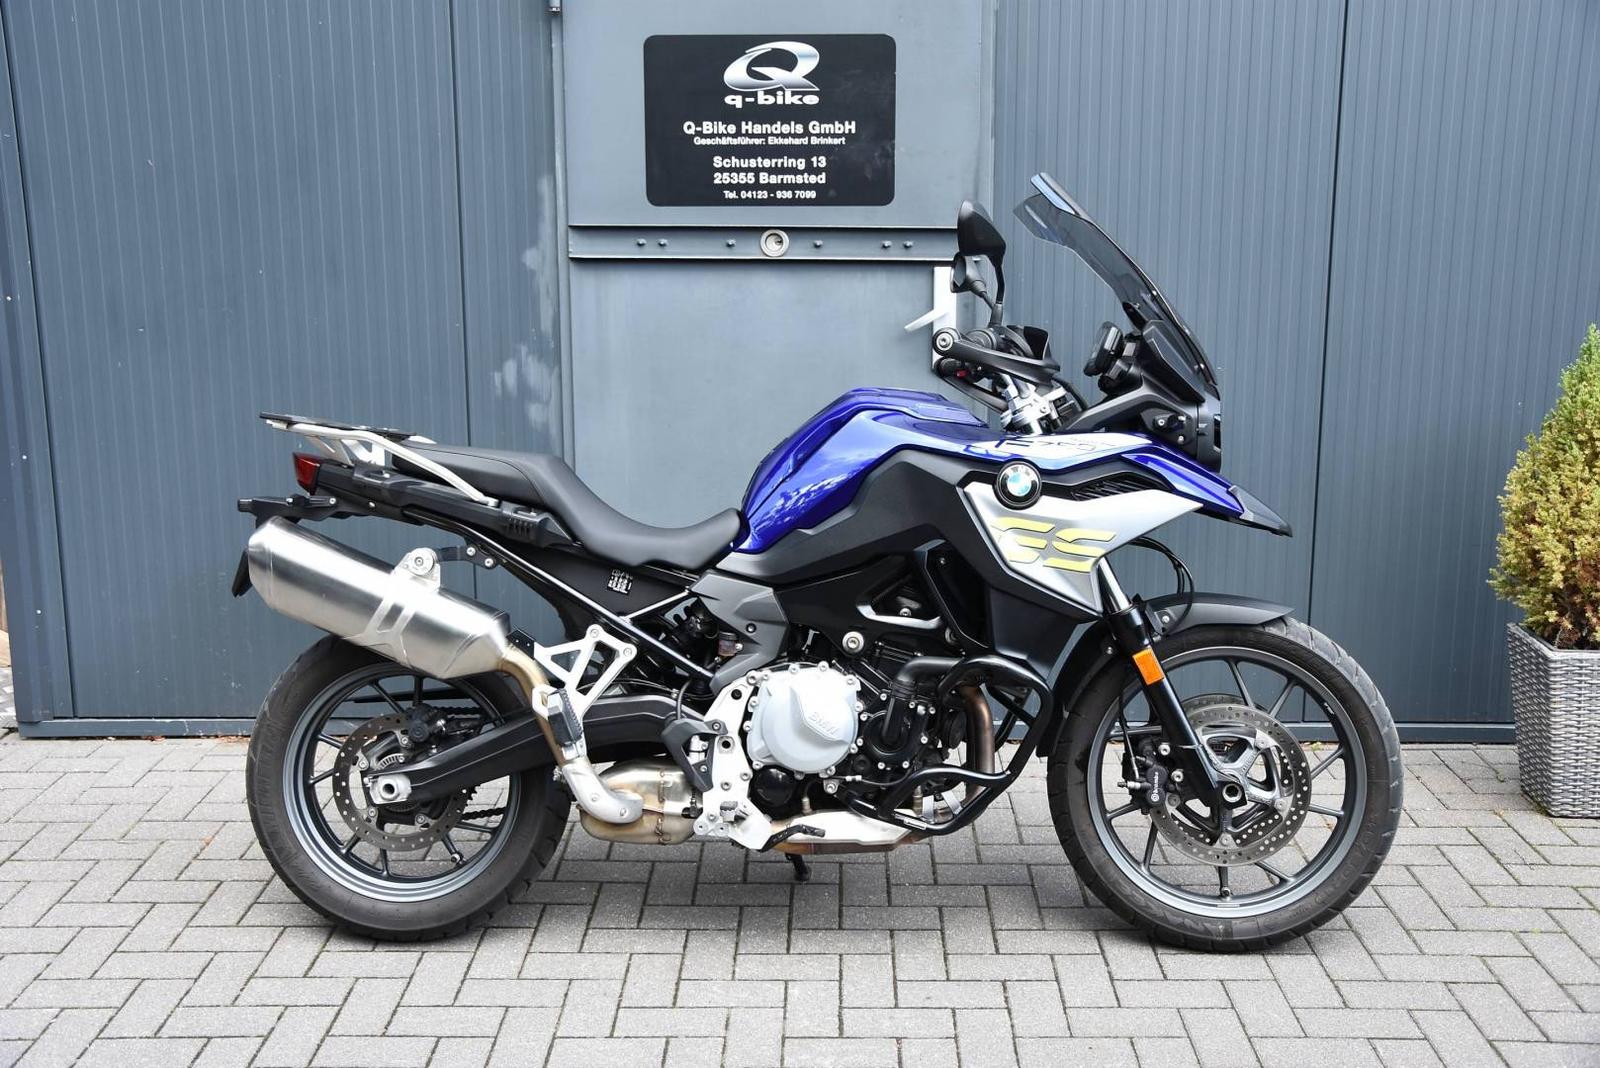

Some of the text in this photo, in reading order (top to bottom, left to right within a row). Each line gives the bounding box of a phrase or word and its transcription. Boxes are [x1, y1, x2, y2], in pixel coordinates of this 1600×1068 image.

[724, 91, 820, 108] q-bike
[683, 120, 856, 135] Q-Bike Handels GmbH
[693, 136, 846, 146] Geschäftsführer: Ekkehard Brinkert
[713, 155, 827, 171] Schusterring 13
[714, 171, 826, 184] 25355 Barmsted
[723, 190, 739, 199] Tel.
[741, 190, 768, 199] 04123
[794, 190, 816, 199] 7099
